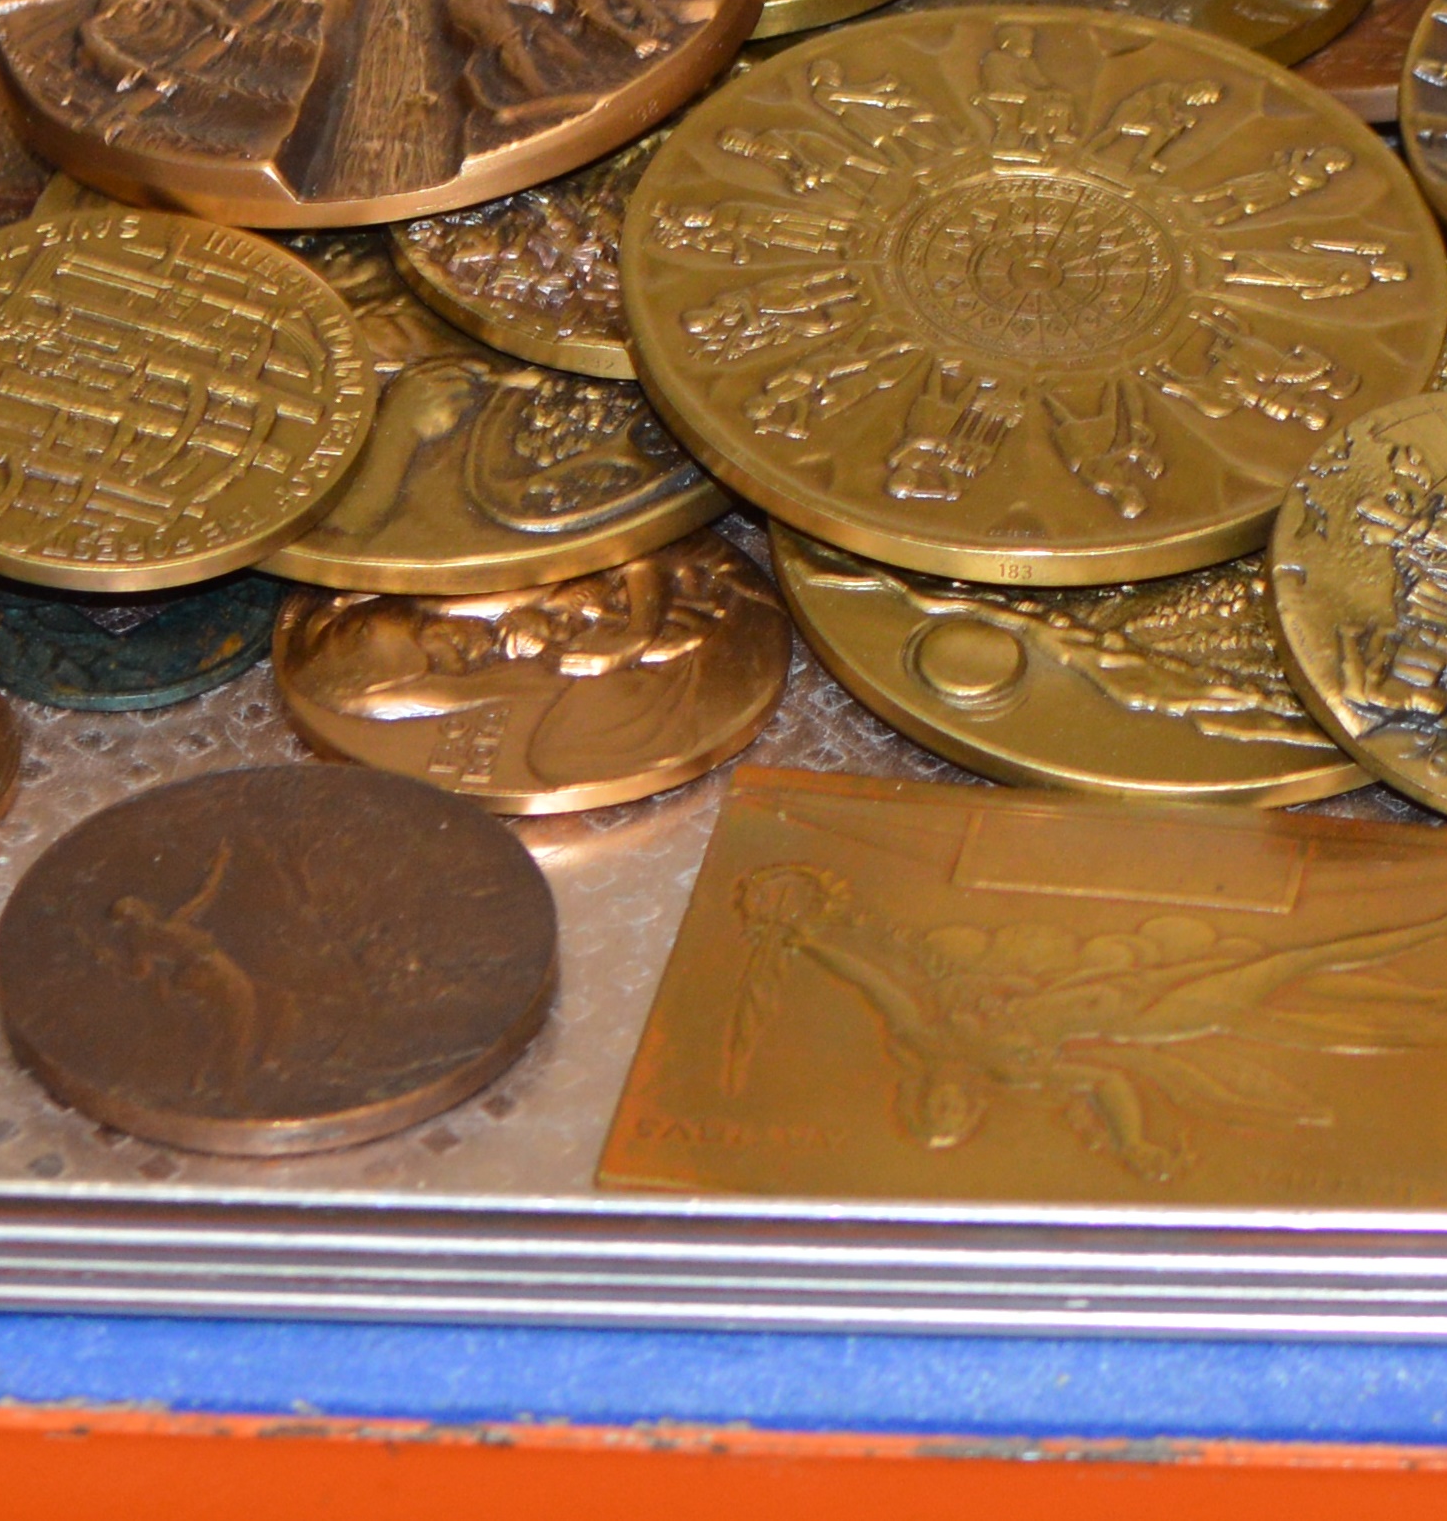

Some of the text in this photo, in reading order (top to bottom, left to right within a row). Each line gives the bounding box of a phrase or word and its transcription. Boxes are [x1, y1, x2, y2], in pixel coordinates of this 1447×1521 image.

[35, 213, 143, 247] SAVE
[300, 407, 364, 480] YEAR
[199, 503, 272, 545] THE
[998, 564, 1034, 580] 183
